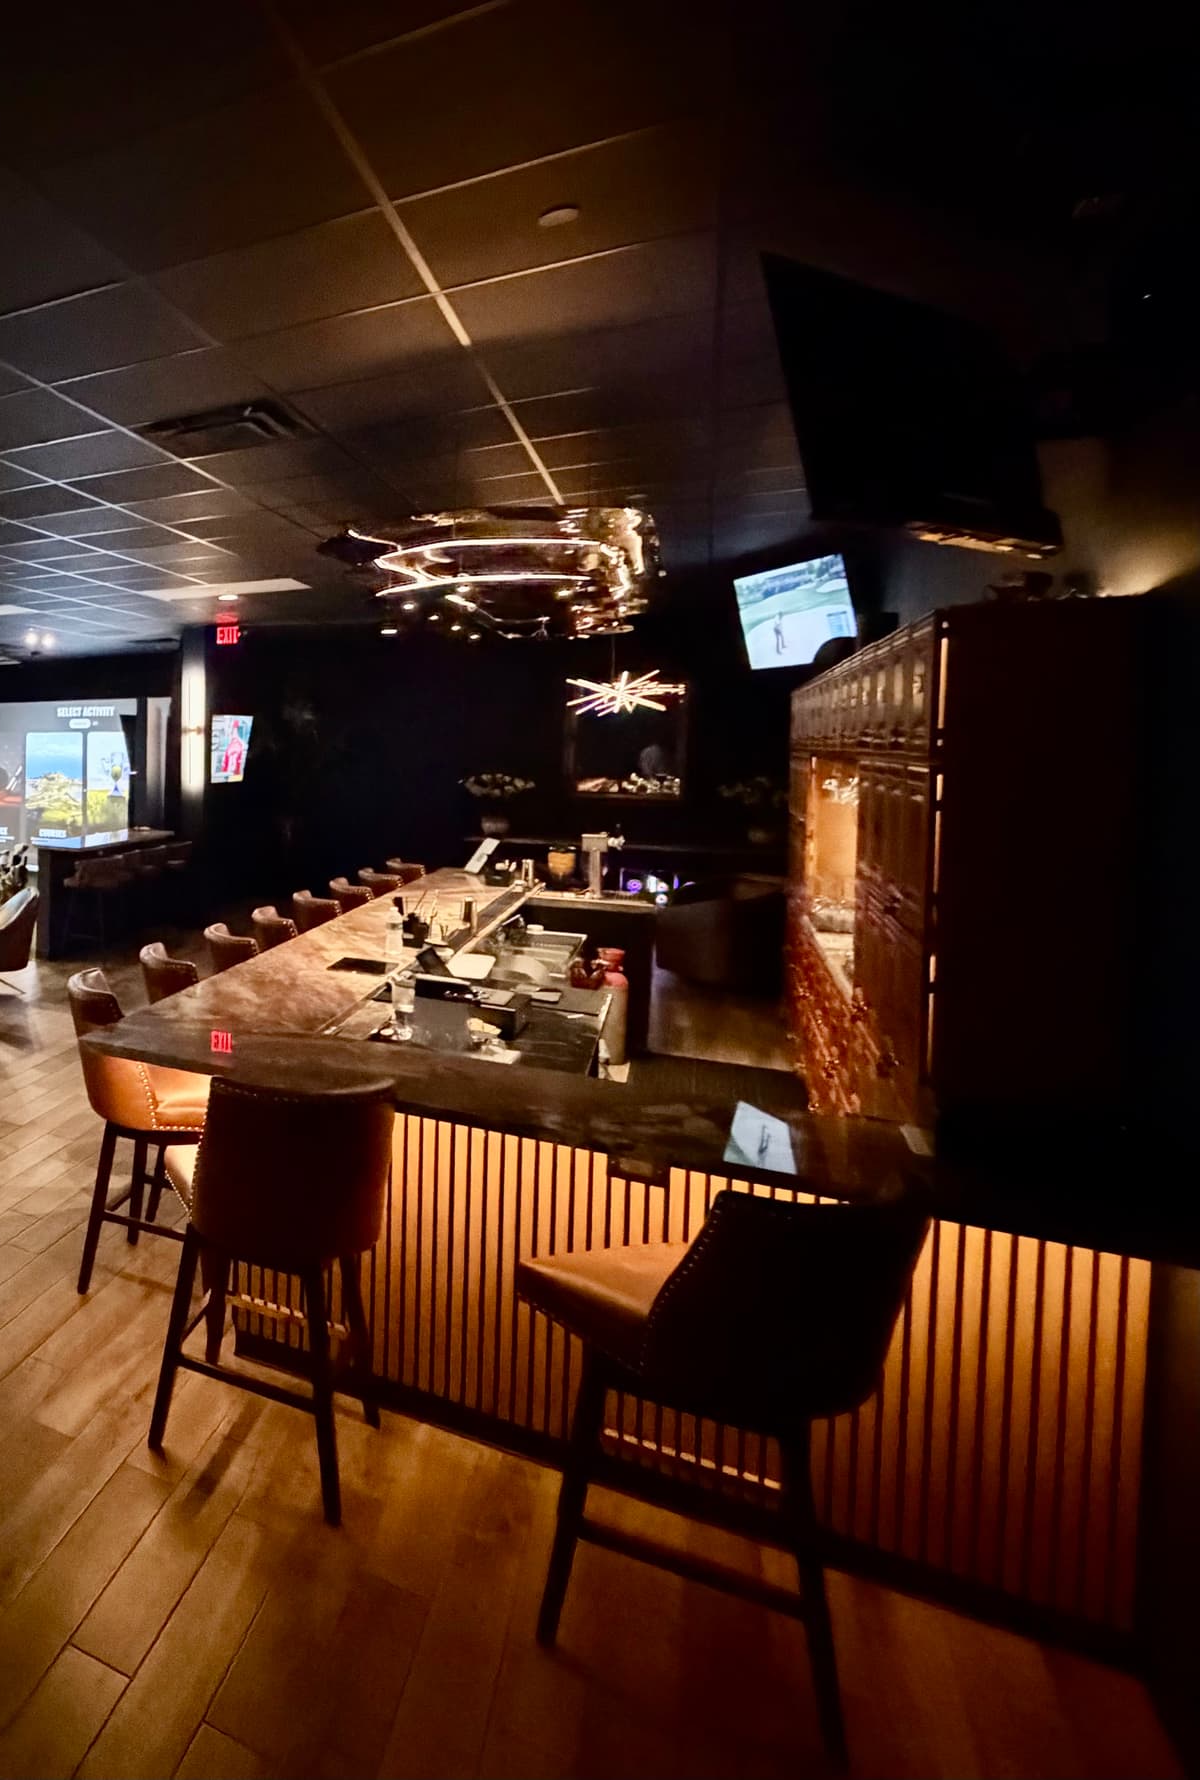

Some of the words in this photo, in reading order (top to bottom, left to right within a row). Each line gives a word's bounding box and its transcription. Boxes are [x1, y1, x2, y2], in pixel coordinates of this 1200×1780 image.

[216, 626, 239, 645] EXIT
[57, 707, 81, 717] SELECT
[82, 706, 115, 717] ACTIVITY
